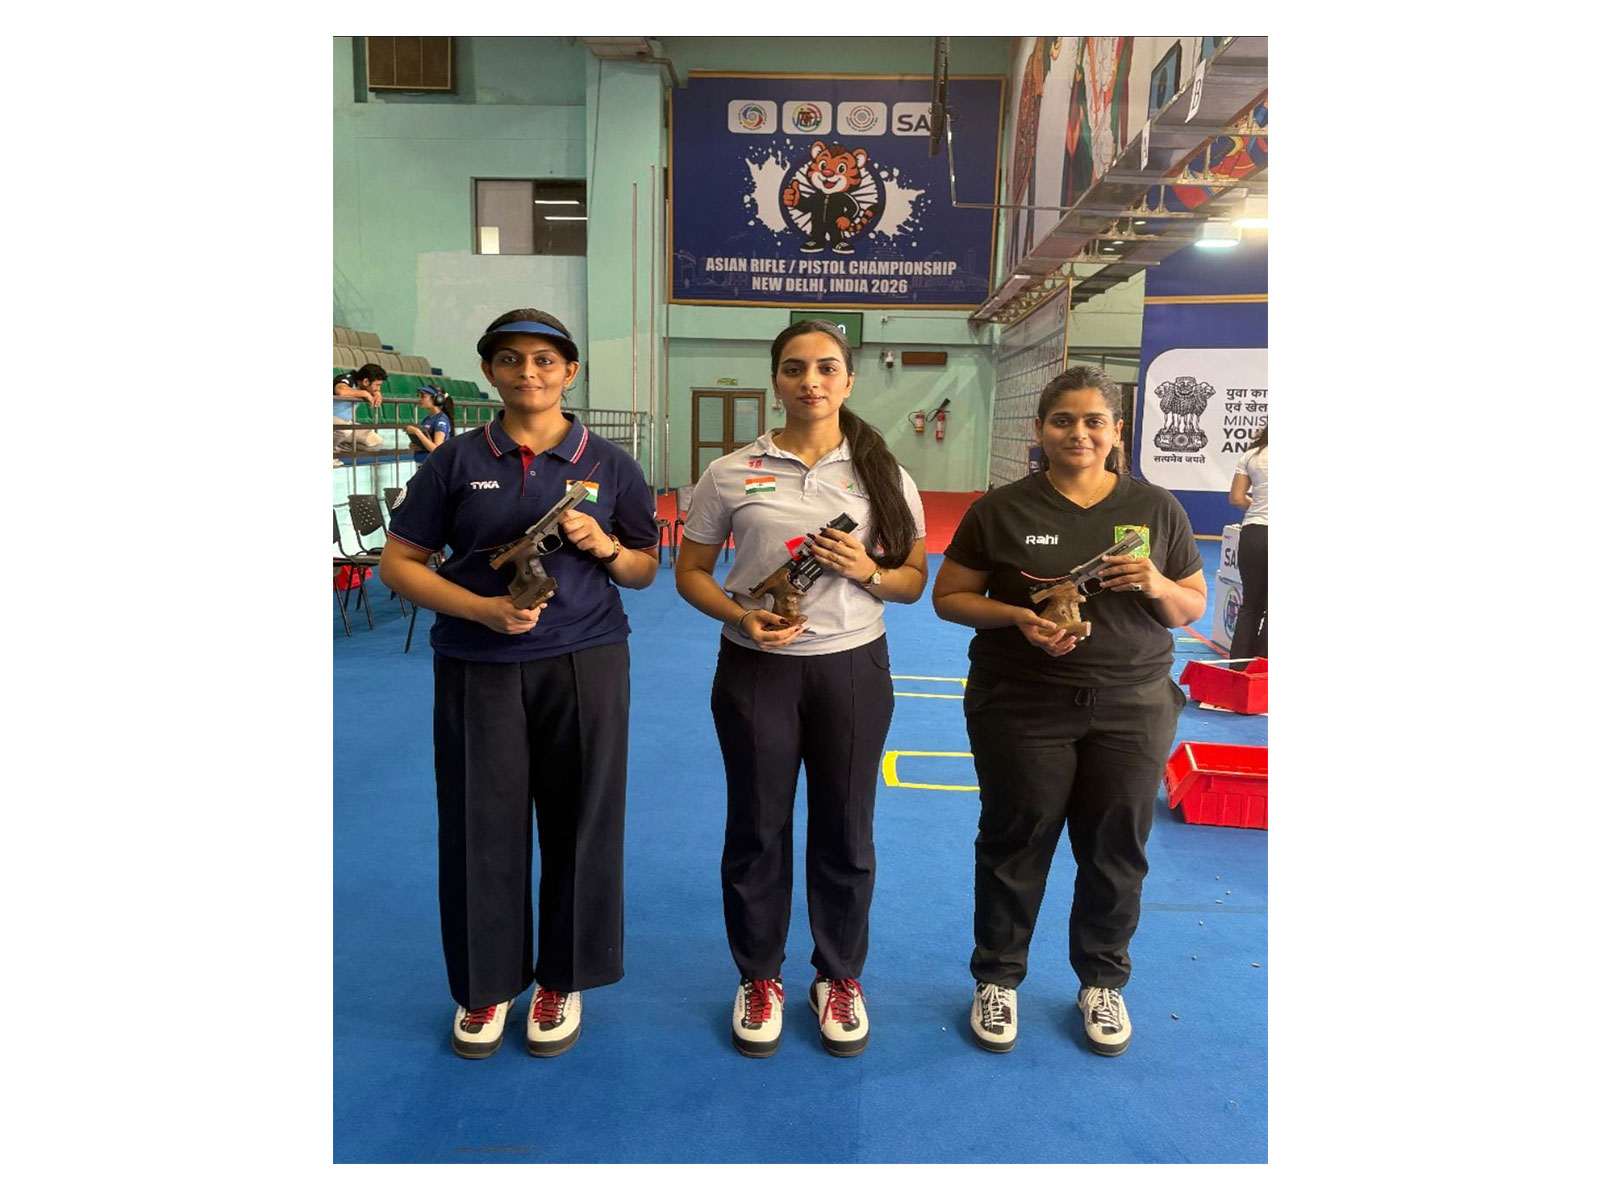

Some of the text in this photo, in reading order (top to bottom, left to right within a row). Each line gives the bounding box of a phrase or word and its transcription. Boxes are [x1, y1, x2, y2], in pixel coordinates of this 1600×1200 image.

[705, 257, 957, 276] ASIAN RIFLE / PISTOL CHAMPIONSHIP
[752, 276, 908, 294] NEW DELHI, INDIA 2026
[1226, 388, 1248, 400] युवा
[1225, 400, 1268, 413] एवं खेल
[470, 480, 500, 490] TYKA
[1025, 533, 1059, 545] Rahi
